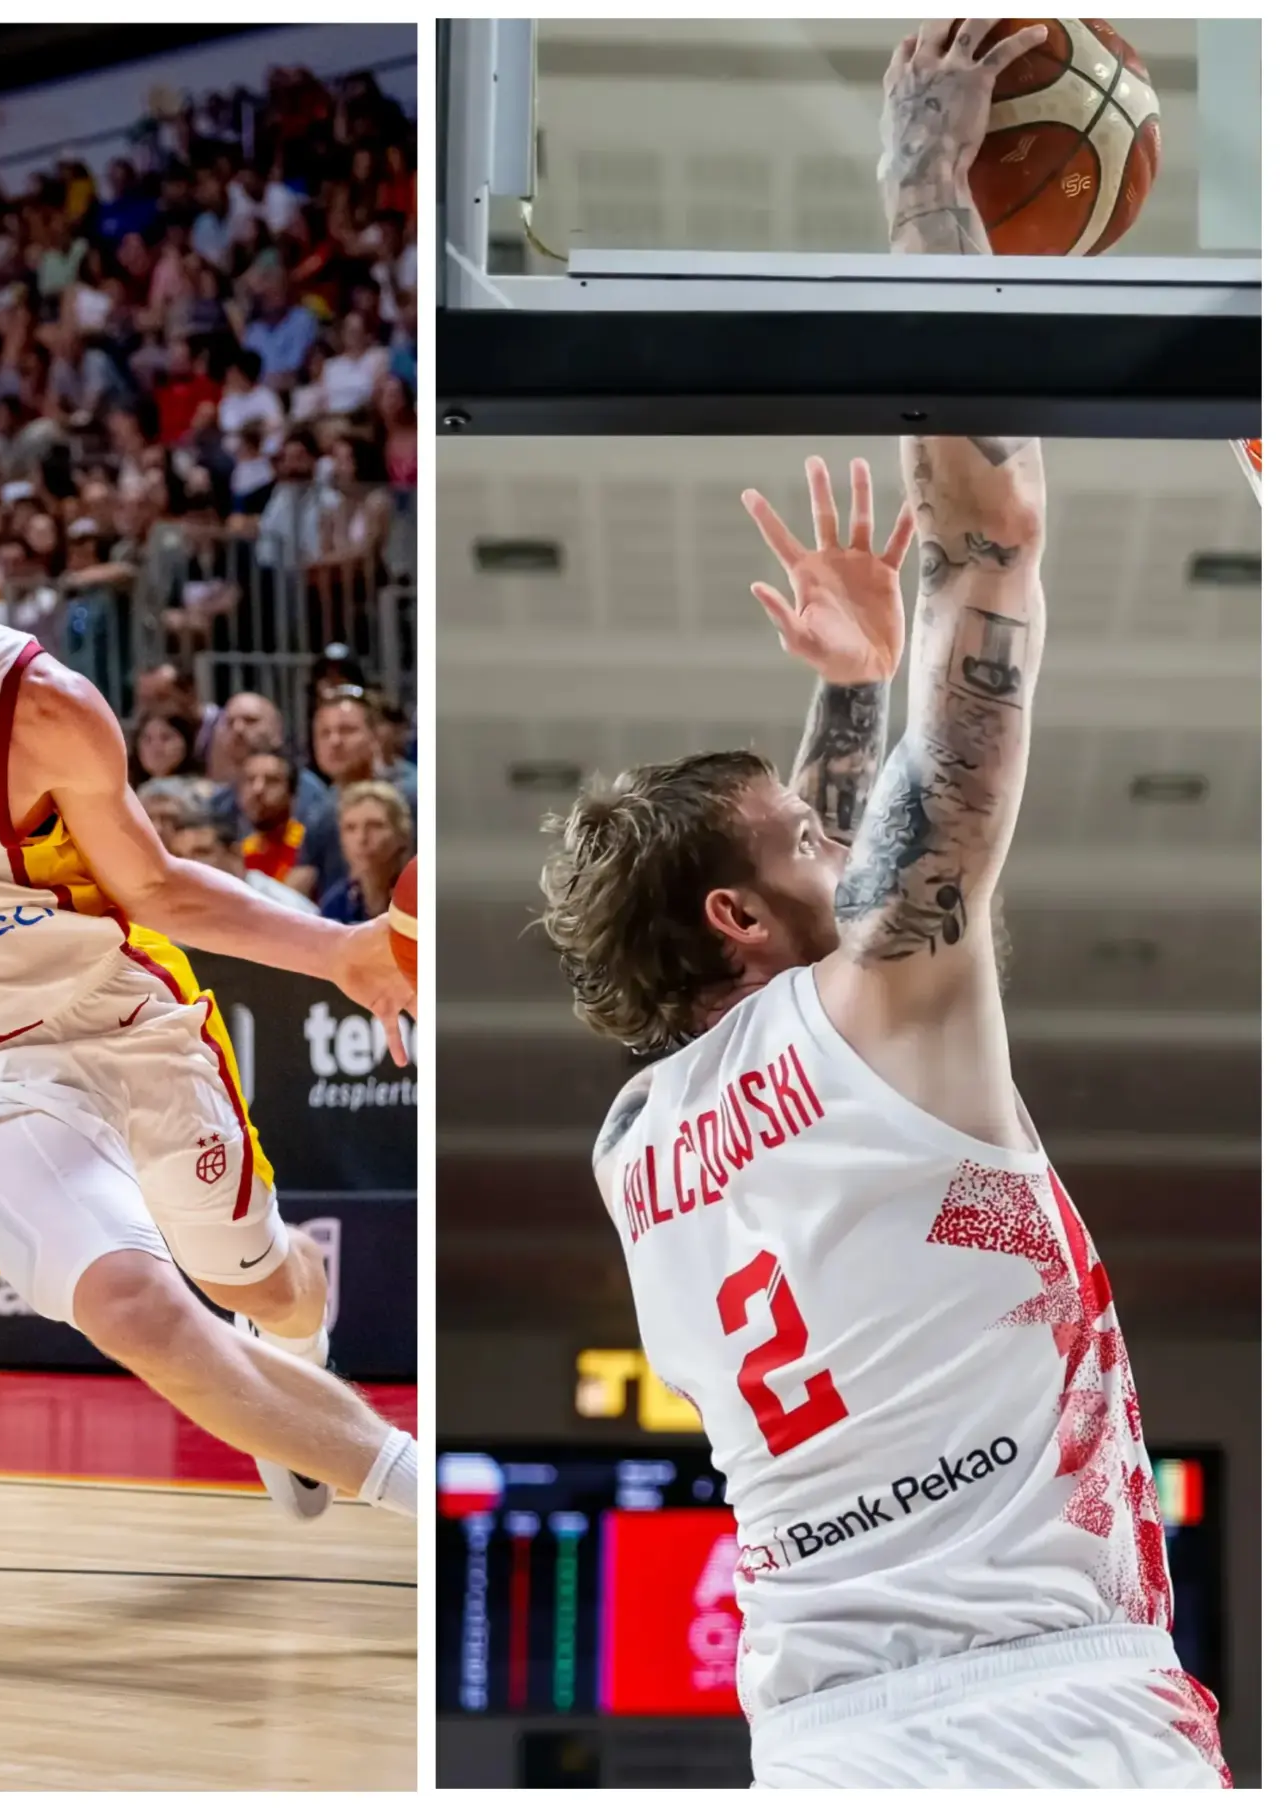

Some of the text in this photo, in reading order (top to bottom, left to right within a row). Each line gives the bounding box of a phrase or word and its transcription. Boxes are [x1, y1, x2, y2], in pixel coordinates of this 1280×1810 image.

[304, 1001, 417, 1077] ten
[716, 1249, 849, 1458] 2
[786, 1435, 1019, 1559] Bank Pekao
